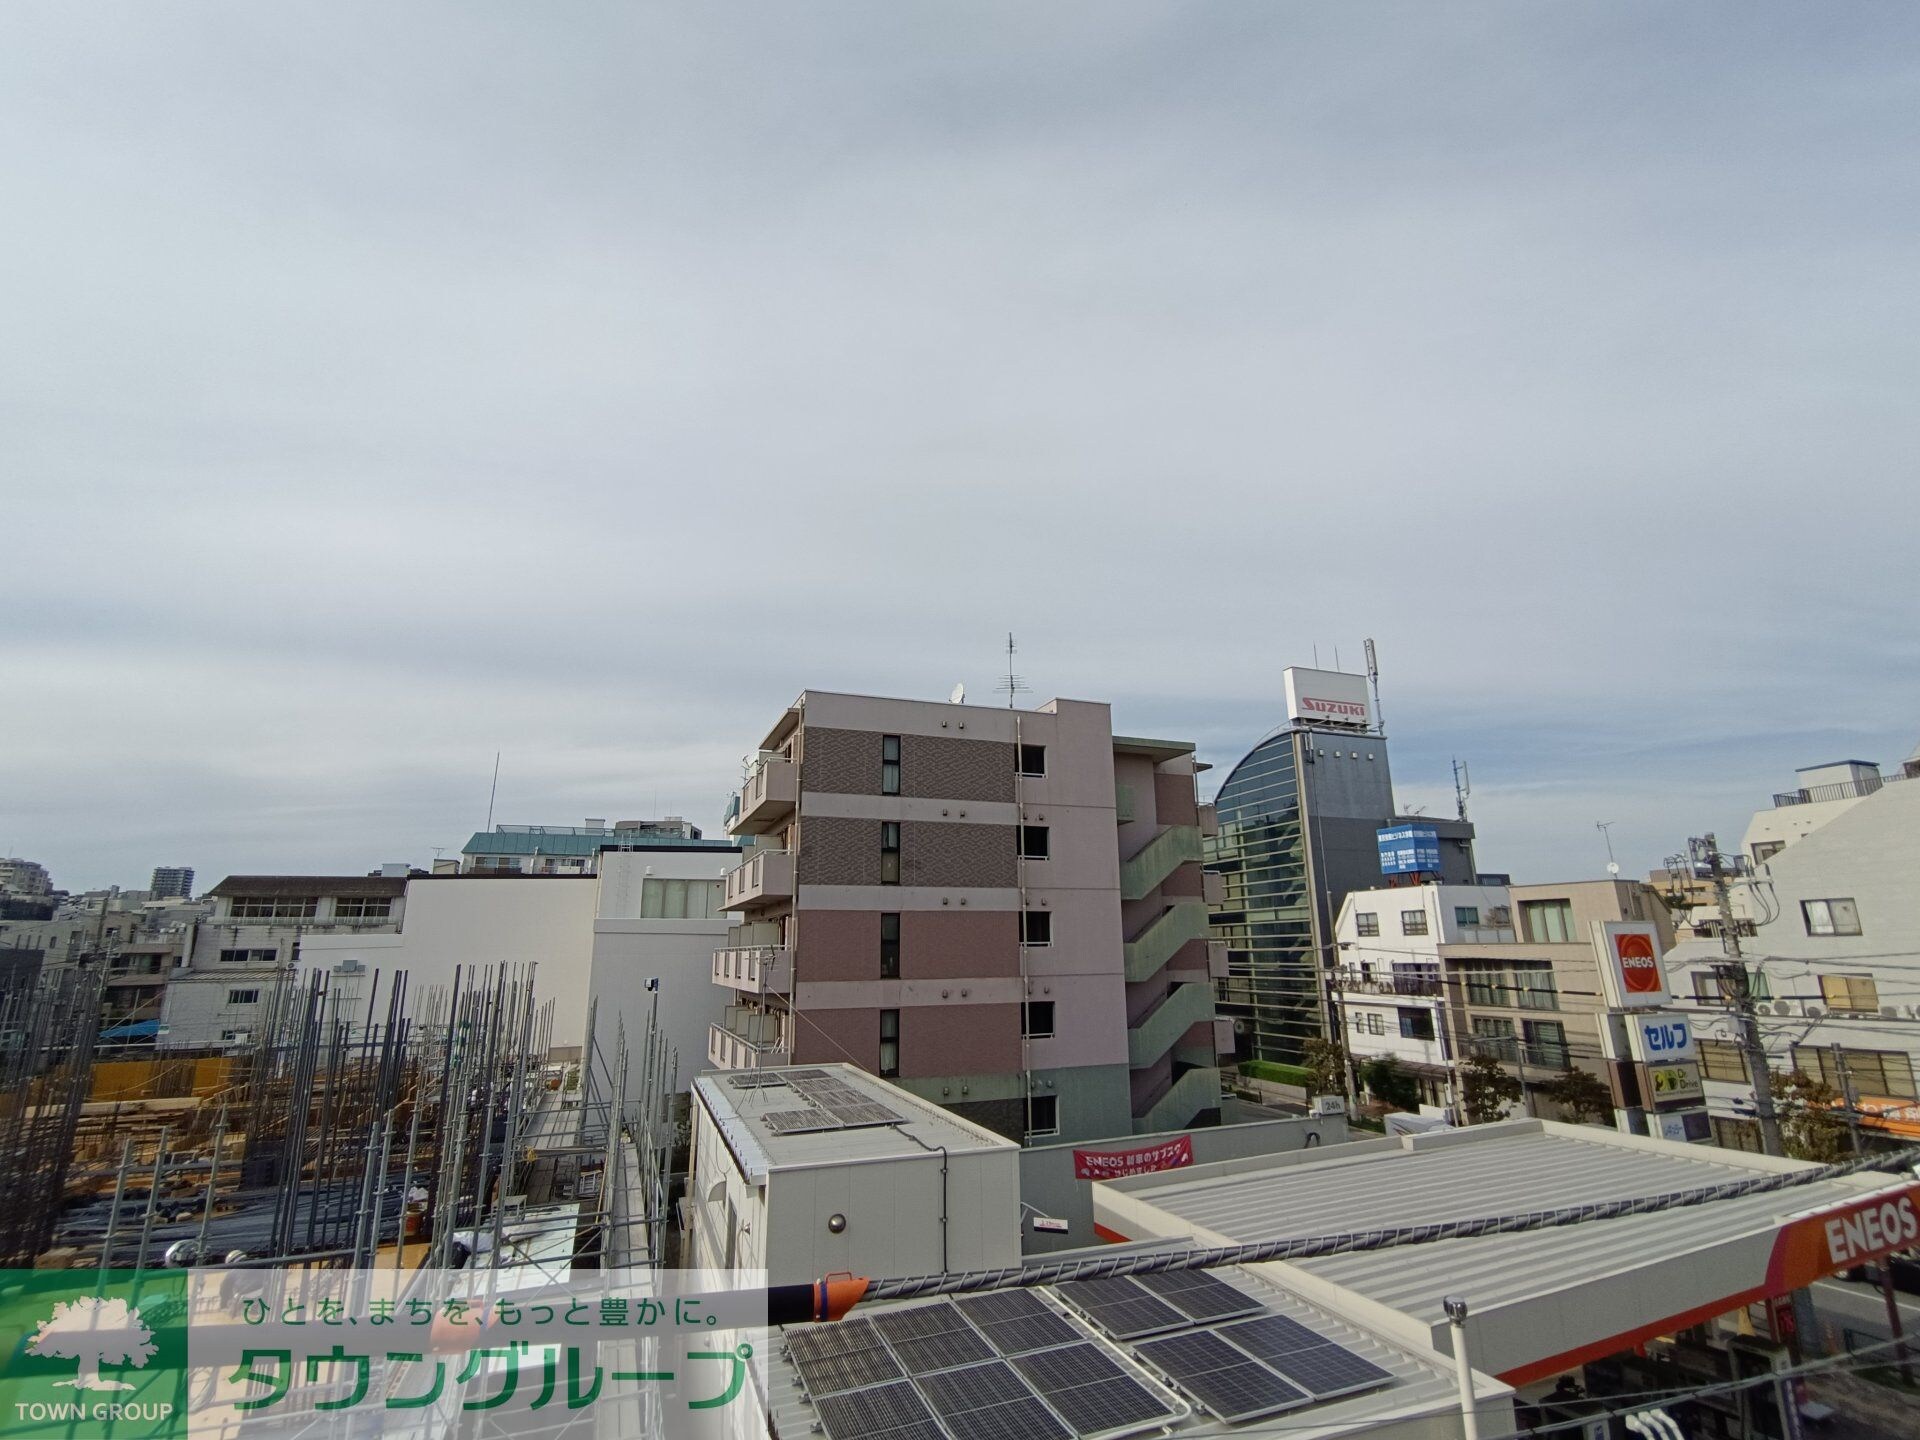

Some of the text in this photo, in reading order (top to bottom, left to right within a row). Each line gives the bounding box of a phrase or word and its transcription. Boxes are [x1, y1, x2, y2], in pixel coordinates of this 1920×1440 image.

[1302, 697, 1365, 716] SUZUKI
[1622, 956, 1654, 969] ENEOS
[1644, 1023, 1687, 1051] セルフ
[1680, 1078, 1699, 1089] Drive
[1326, 1101, 1341, 1111] 24h
[1085, 1156, 1124, 1167] ENEOS
[1824, 1196, 1918, 1264] ENEOS
